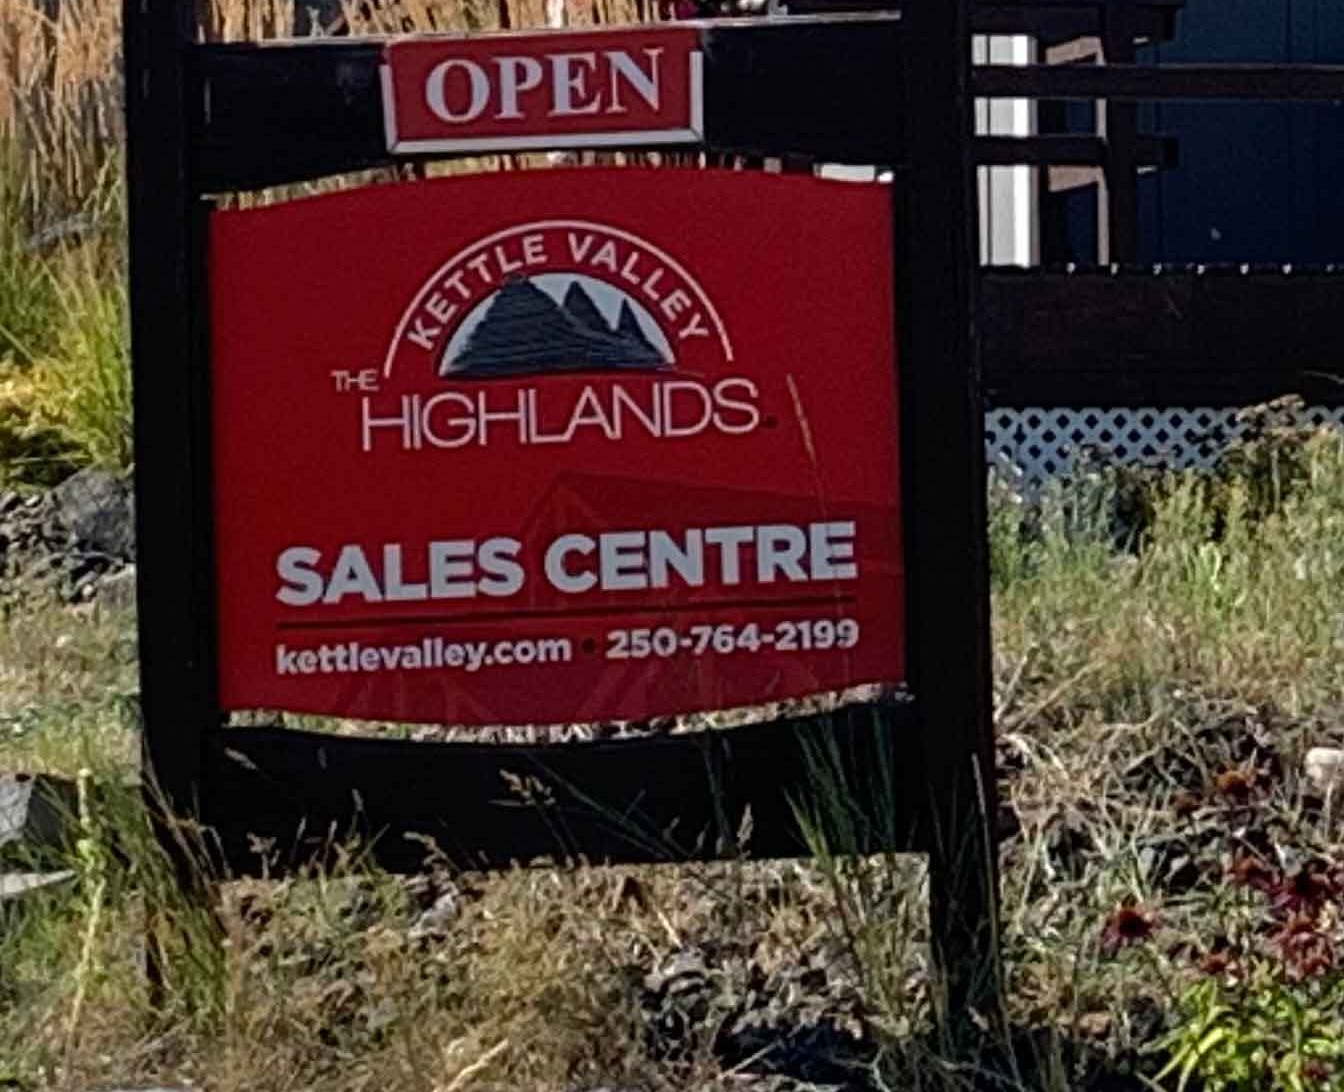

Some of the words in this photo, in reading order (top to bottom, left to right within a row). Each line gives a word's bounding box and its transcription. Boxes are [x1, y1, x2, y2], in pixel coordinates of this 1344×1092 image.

[425, 46, 665, 125] OPEN
[407, 233, 548, 350] KETTLE
[567, 232, 710, 342] VALLEY
[331, 368, 379, 392] THE
[361, 377, 760, 452] HIGHLANDS
[275, 535, 525, 606] SALES
[543, 520, 858, 592] CENTRE
[275, 634, 572, 675] kettlevalley.com
[604, 618, 860, 660] 250-764-2199
